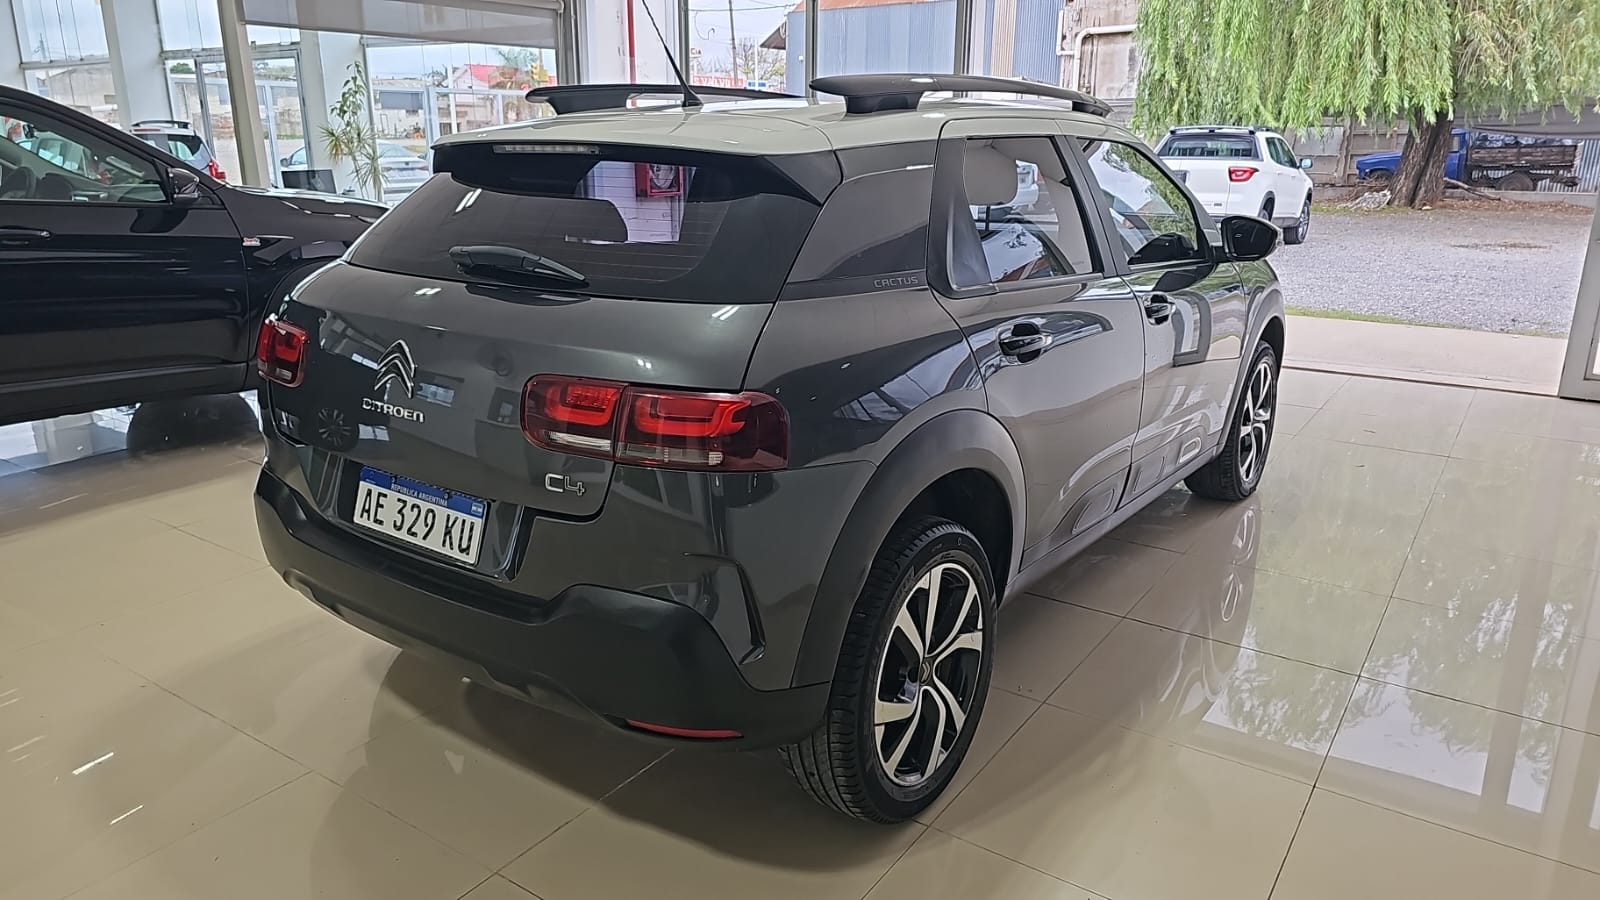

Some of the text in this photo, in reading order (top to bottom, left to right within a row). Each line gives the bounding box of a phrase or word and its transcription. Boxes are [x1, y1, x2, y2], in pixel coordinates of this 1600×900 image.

[873, 275, 919, 288] CACTUS
[545, 473, 585, 496] C4
[418, 491, 448, 507] ARGENTINA
[360, 488, 475, 556] AE 329 KU
